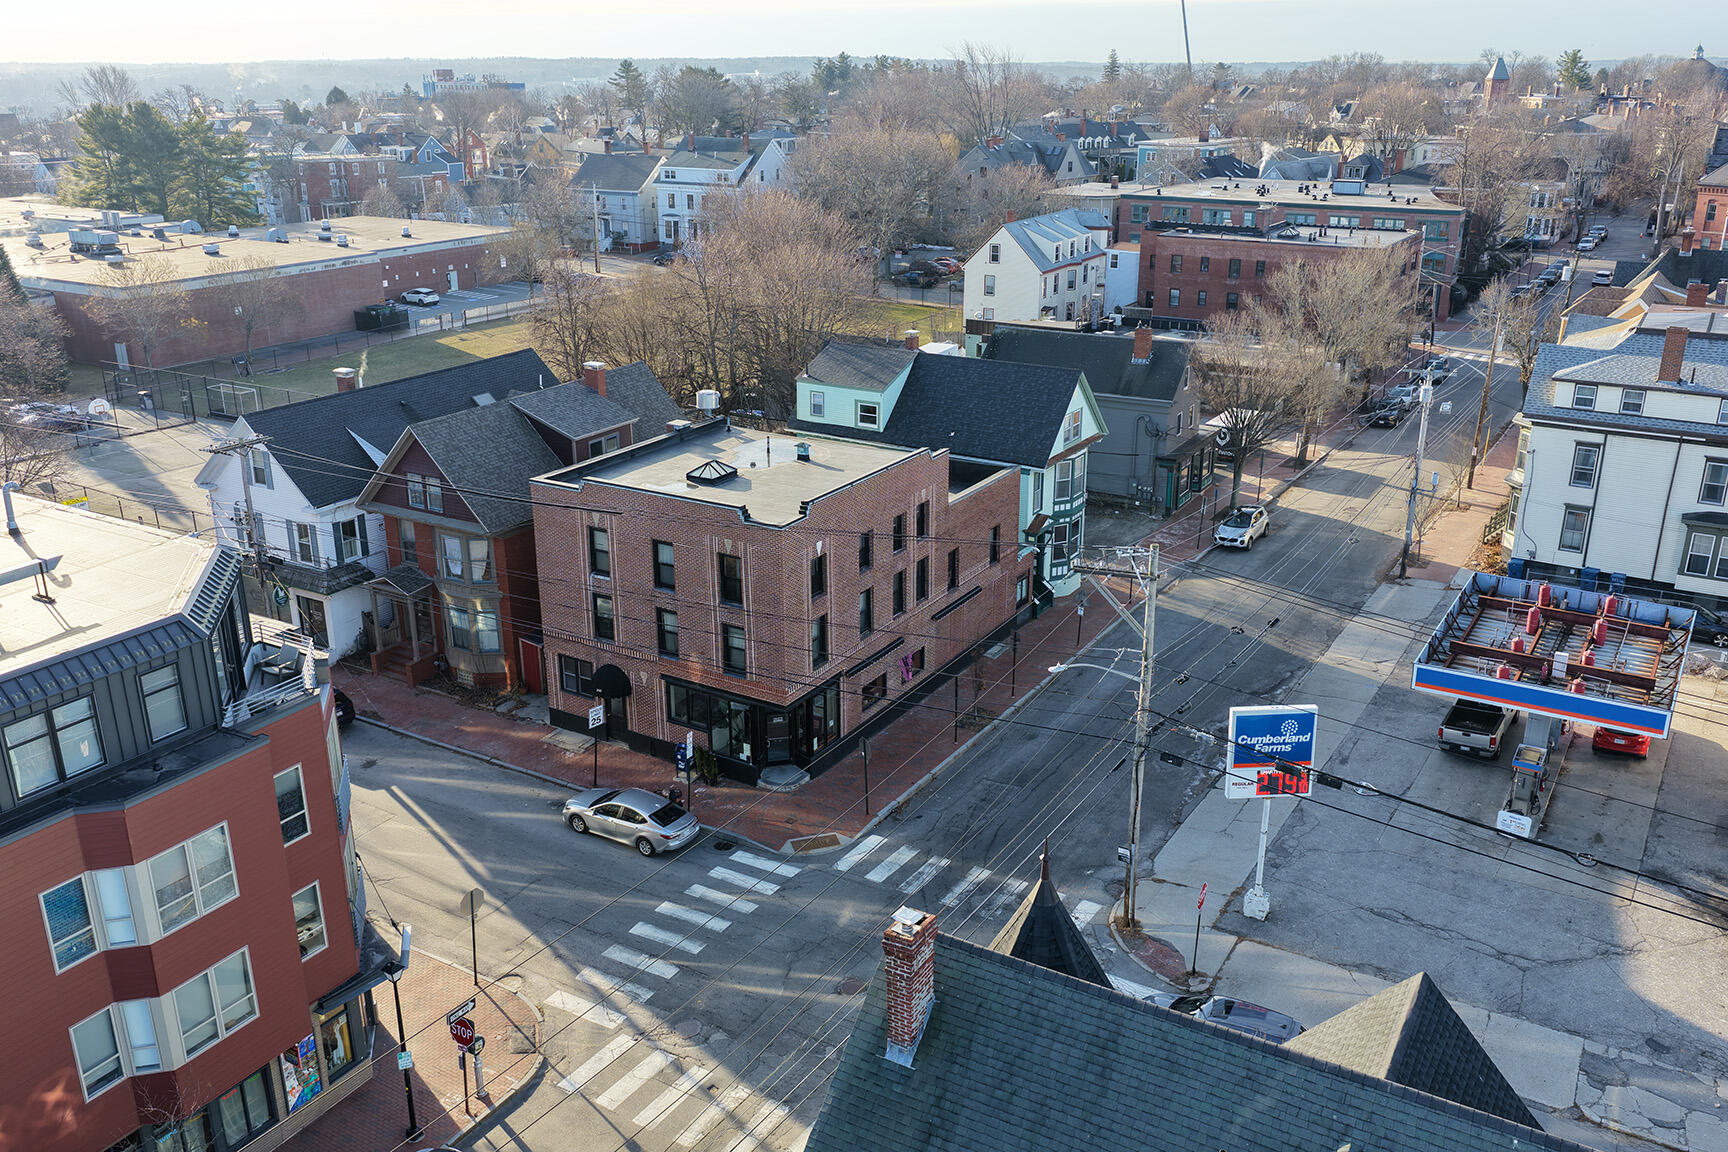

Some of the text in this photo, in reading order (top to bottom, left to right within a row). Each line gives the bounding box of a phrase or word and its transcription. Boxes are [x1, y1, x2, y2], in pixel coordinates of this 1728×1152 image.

[591, 716, 602, 726] 25
[1238, 733, 1311, 744] Cumberland
[1253, 743, 1292, 752] Farms
[452, 1024, 473, 1040] STOP
